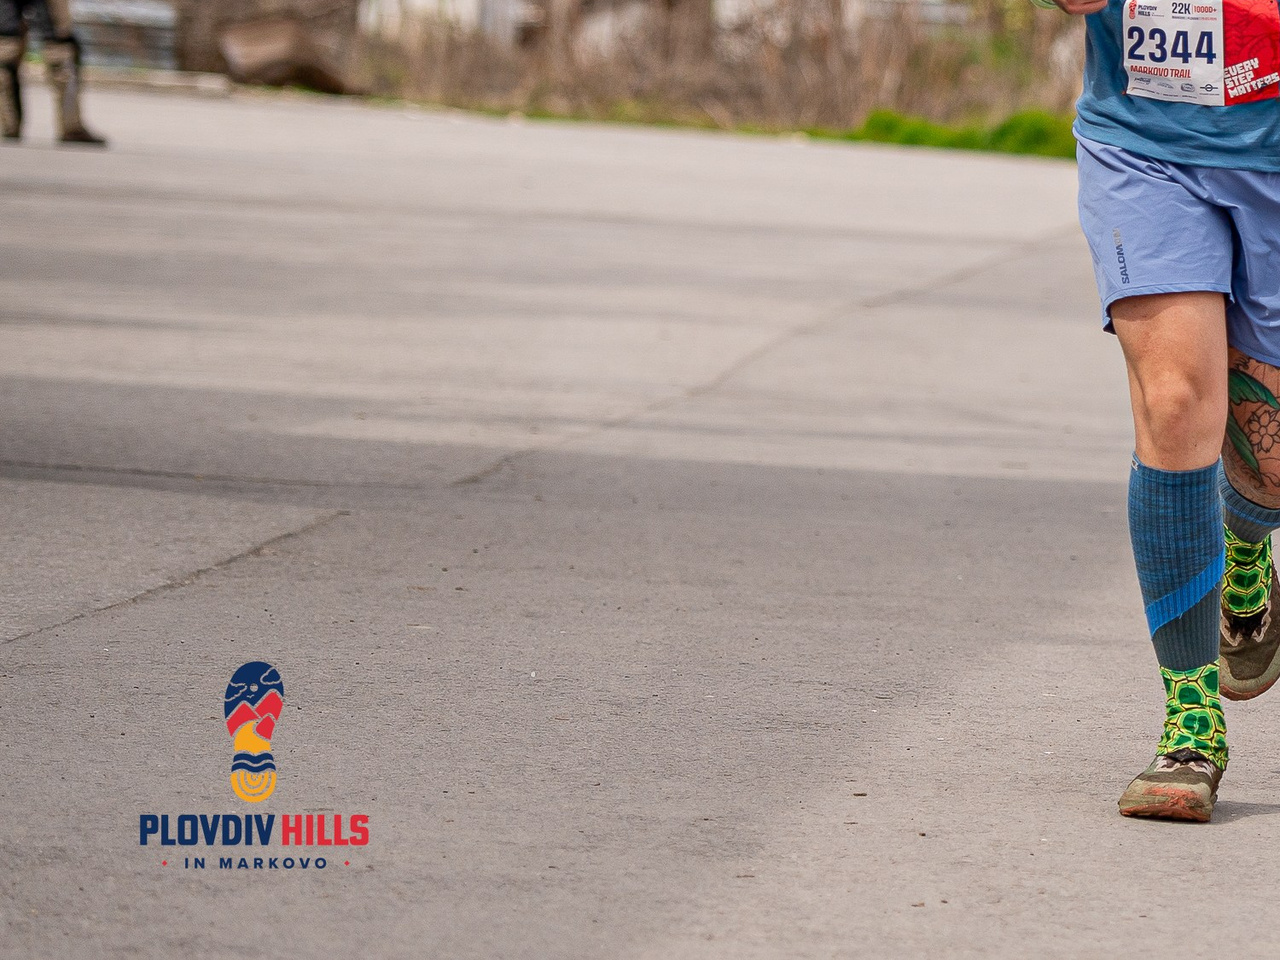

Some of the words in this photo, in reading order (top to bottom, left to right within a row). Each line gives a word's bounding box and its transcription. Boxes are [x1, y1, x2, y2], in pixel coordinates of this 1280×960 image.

[1171, 2, 1191, 15] 22K
[1127, 26, 1216, 64] 2344
[1130, 65, 1168, 78] MARKOVO
[1170, 68, 1191, 79] TRAIL
[1223, 58, 1259, 78] EVERY
[1225, 71, 1255, 88] STEP
[1227, 72, 1280, 98] MATTERS
